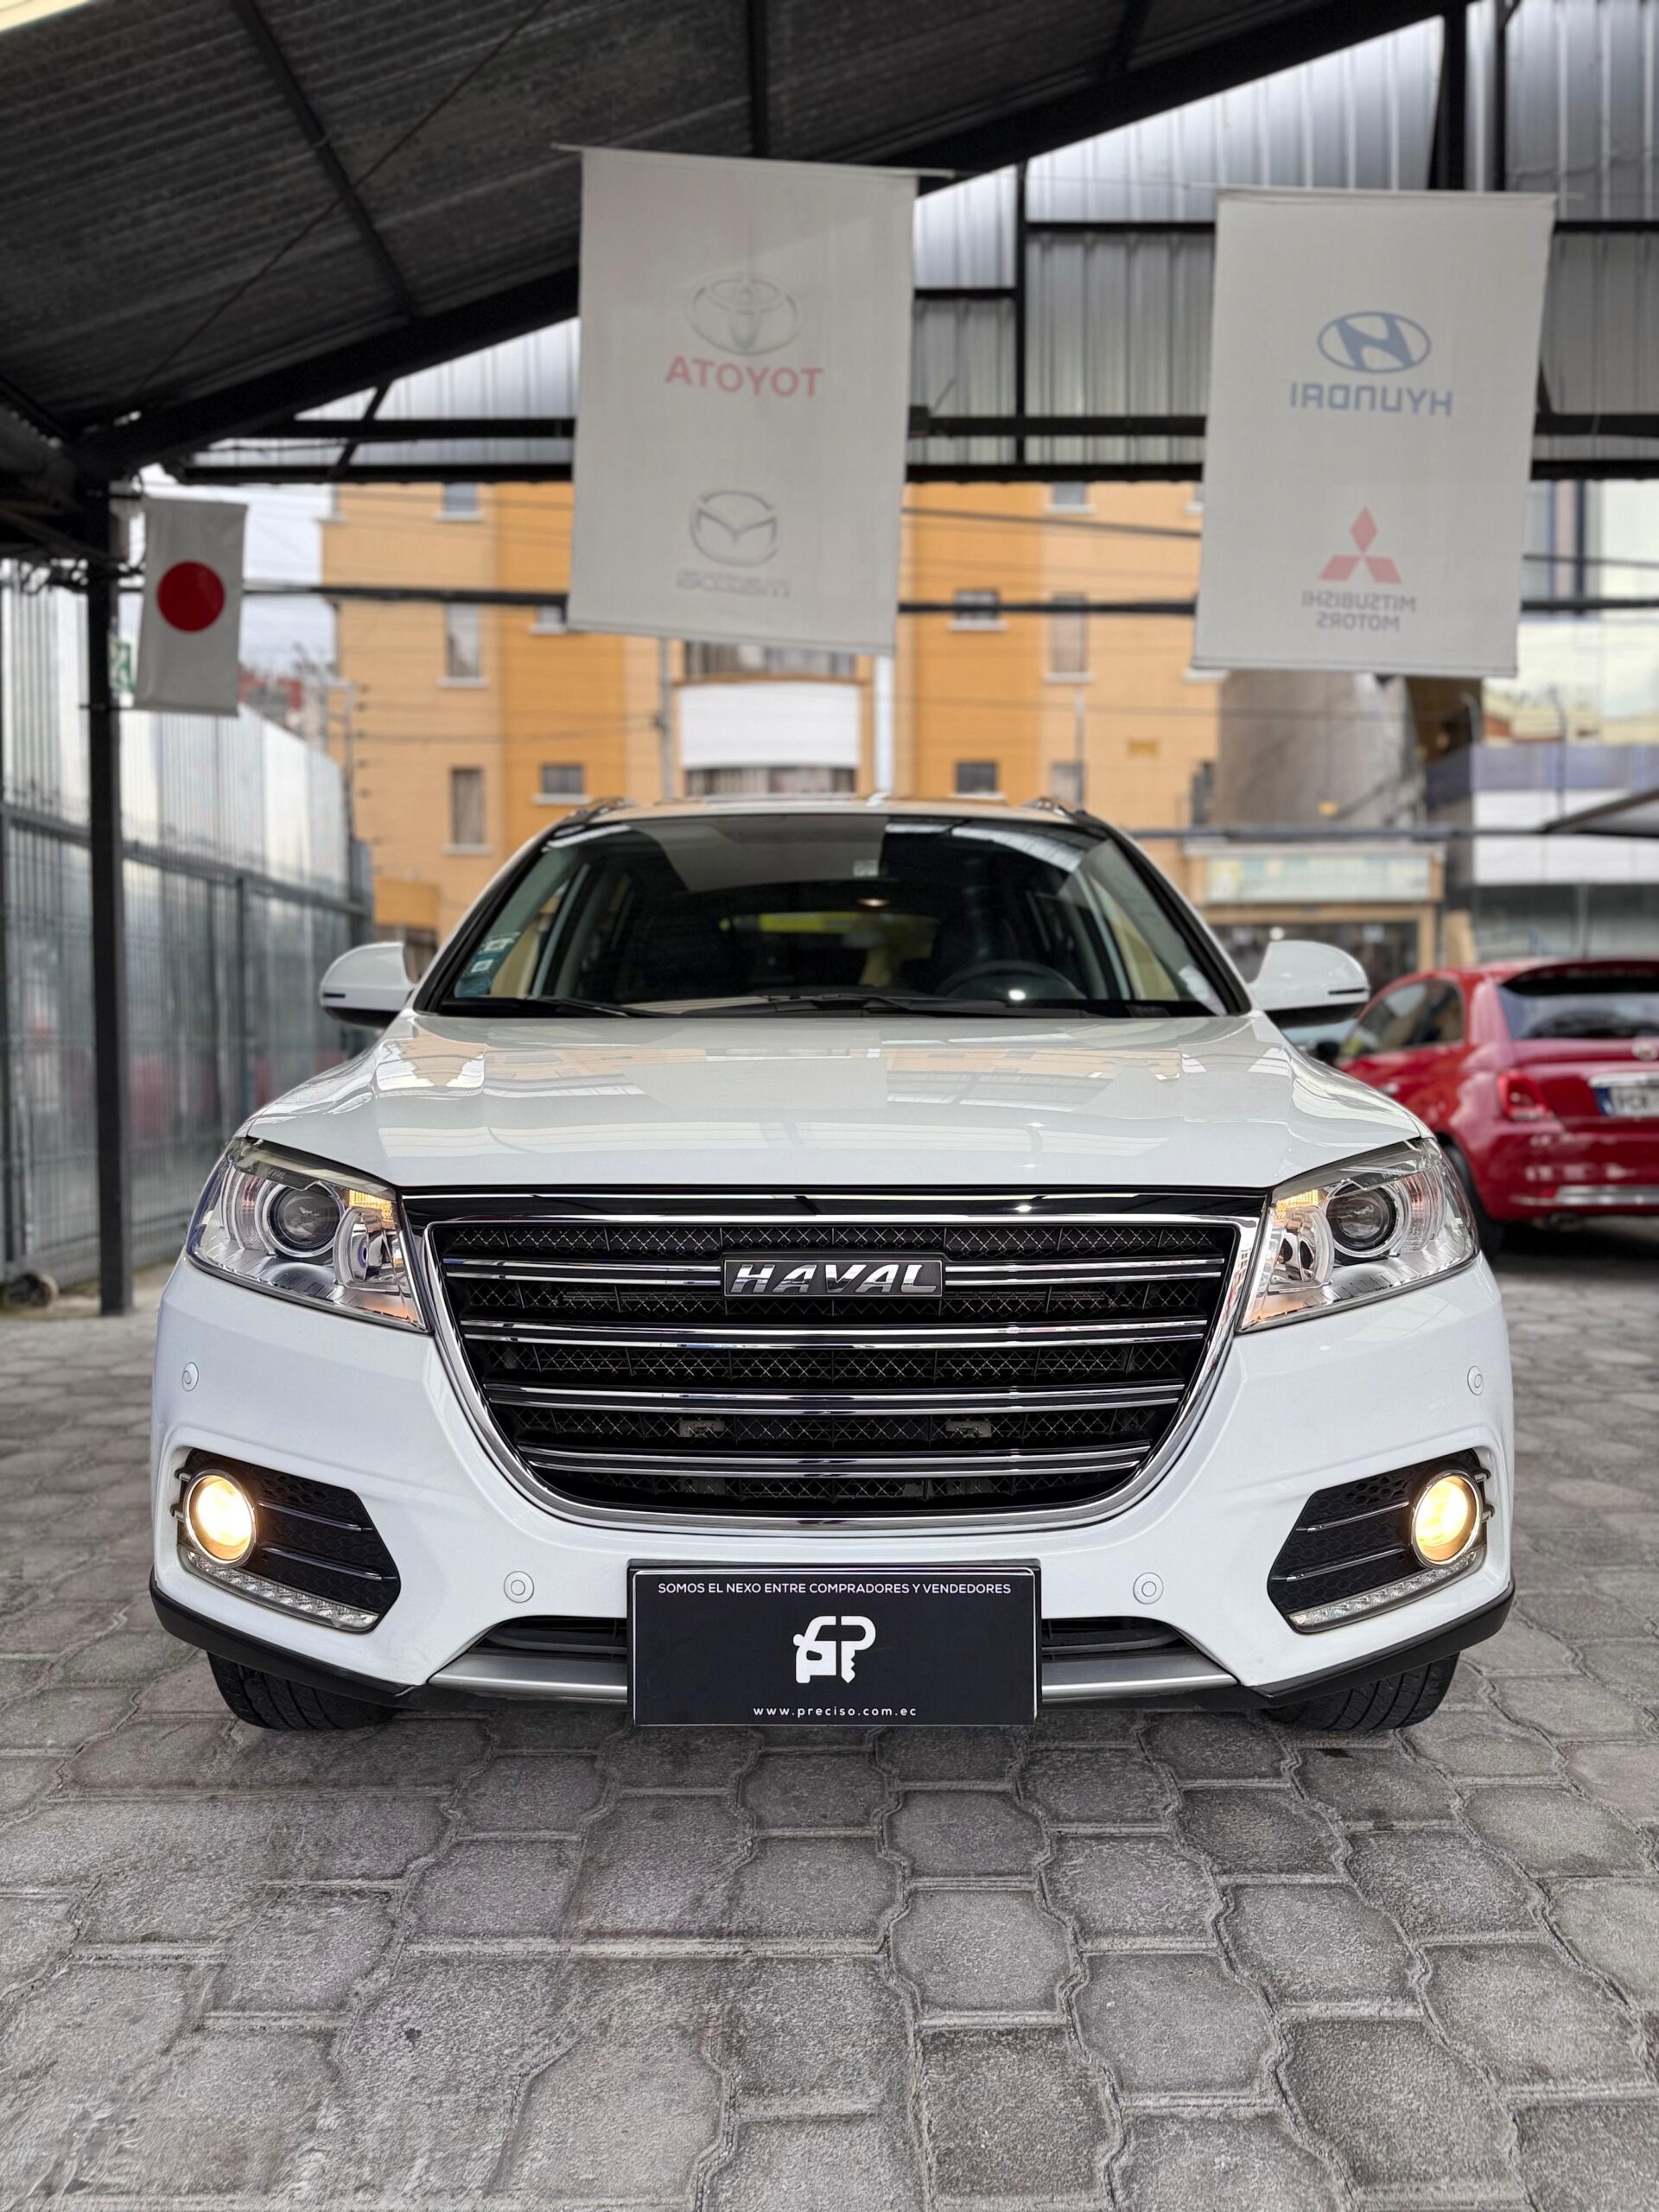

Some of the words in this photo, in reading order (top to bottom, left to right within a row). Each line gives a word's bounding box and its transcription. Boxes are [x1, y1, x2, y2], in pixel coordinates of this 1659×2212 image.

[731, 1264, 937, 1294] HAVAL
[658, 1583, 705, 1593] SOMOS
[708, 1583, 723, 1593] EL
[726, 1583, 761, 1593] NEXO
[764, 1583, 806, 1593] ENTRE
[809, 1583, 910, 1594] COMPRADORES
[912, 1584, 921, 1593] Y
[923, 1584, 1011, 1594] VENDEDORES
[753, 1706, 917, 1718] www.preciso.com.ec
